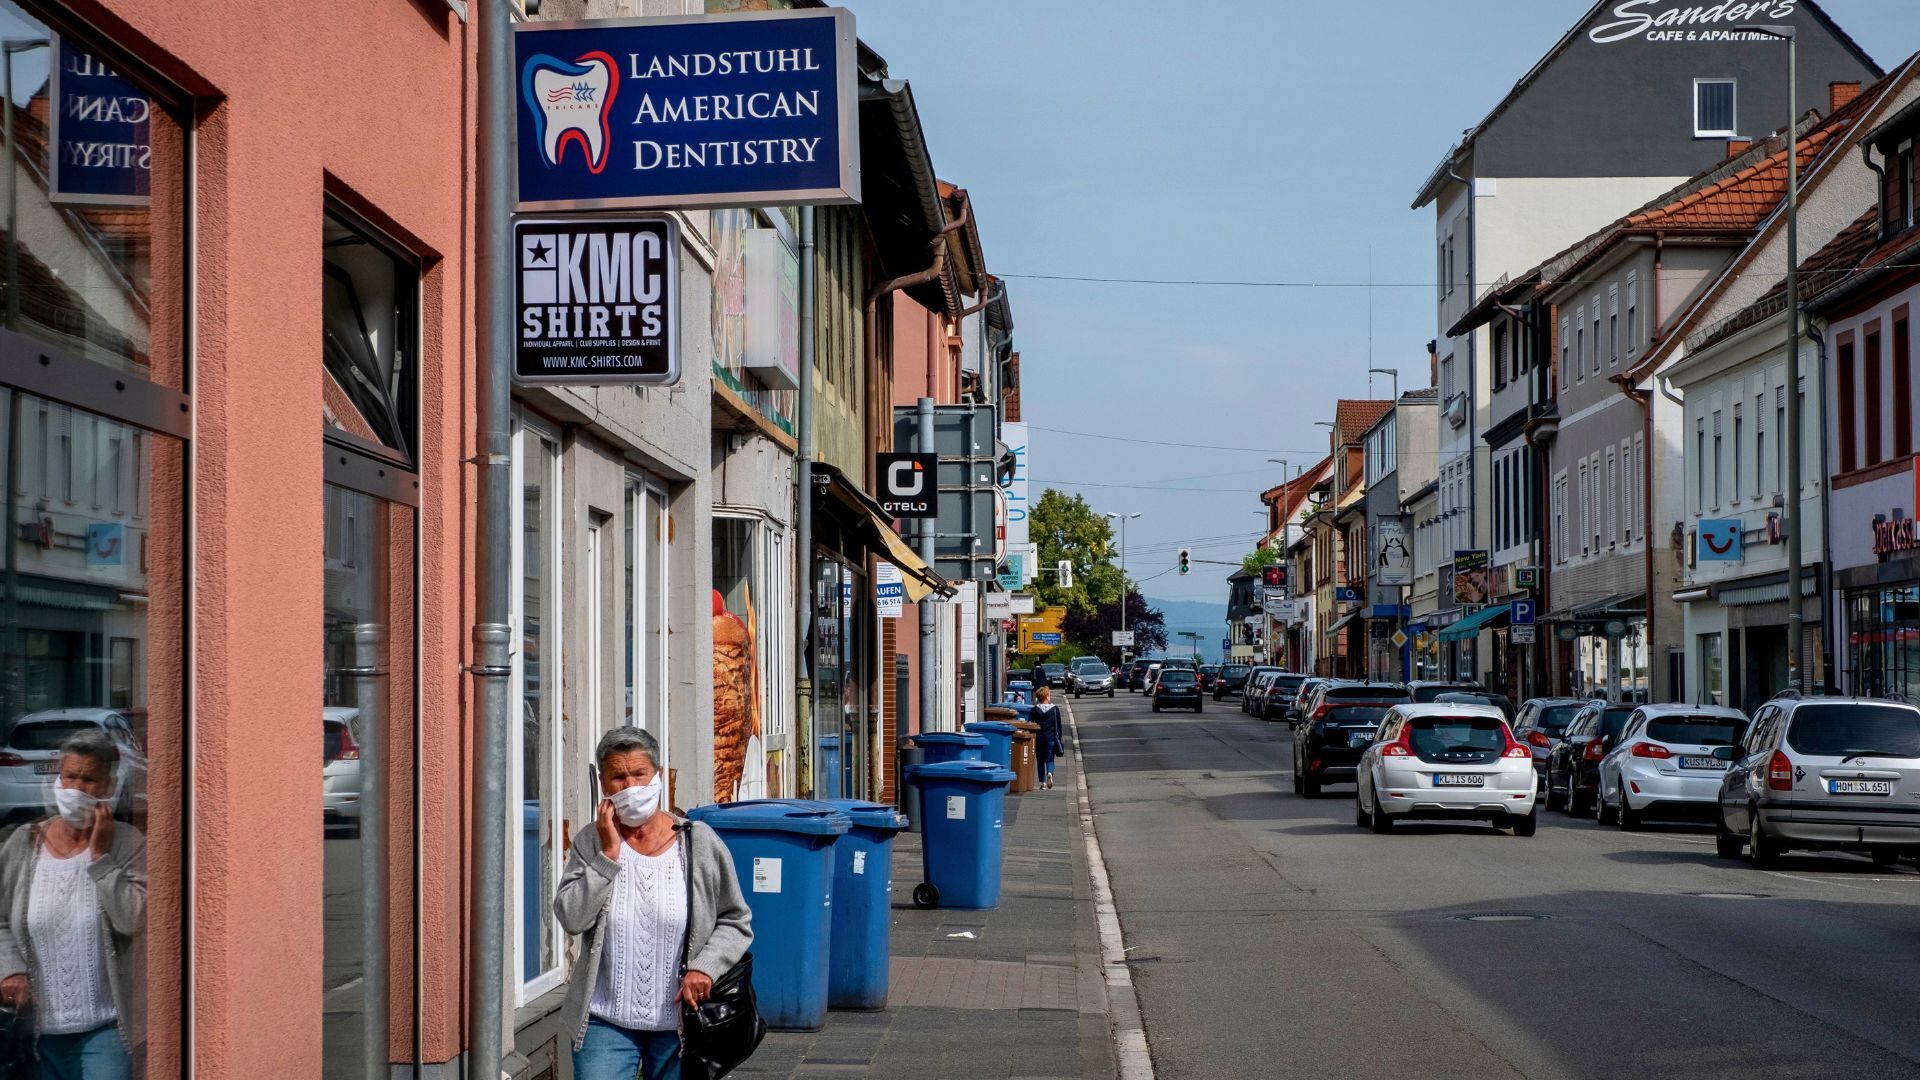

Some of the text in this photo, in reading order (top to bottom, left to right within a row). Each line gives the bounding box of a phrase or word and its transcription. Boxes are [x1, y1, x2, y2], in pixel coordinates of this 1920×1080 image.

[1589, 0, 1797, 43] Sander's
[1647, 30, 1786, 41] CAFE & APARTME
[629, 48, 820, 79] LANDSTUHL
[632, 90, 820, 125] AMERICAN
[632, 137, 822, 171] DENTISTRY
[558, 231, 661, 304] KMC
[523, 305, 662, 339] SHIRTS
[593, 339, 616, 347] SUPPLIES
[543, 355, 643, 368] WWW.KMC-SHIRTS.COM
[1872, 518, 1916, 554] Sparkass
[1516, 602, 1530, 621] P
[1440, 775, 1483, 784] KL IS 606
[1836, 782, 1889, 792] HOM SL 651
